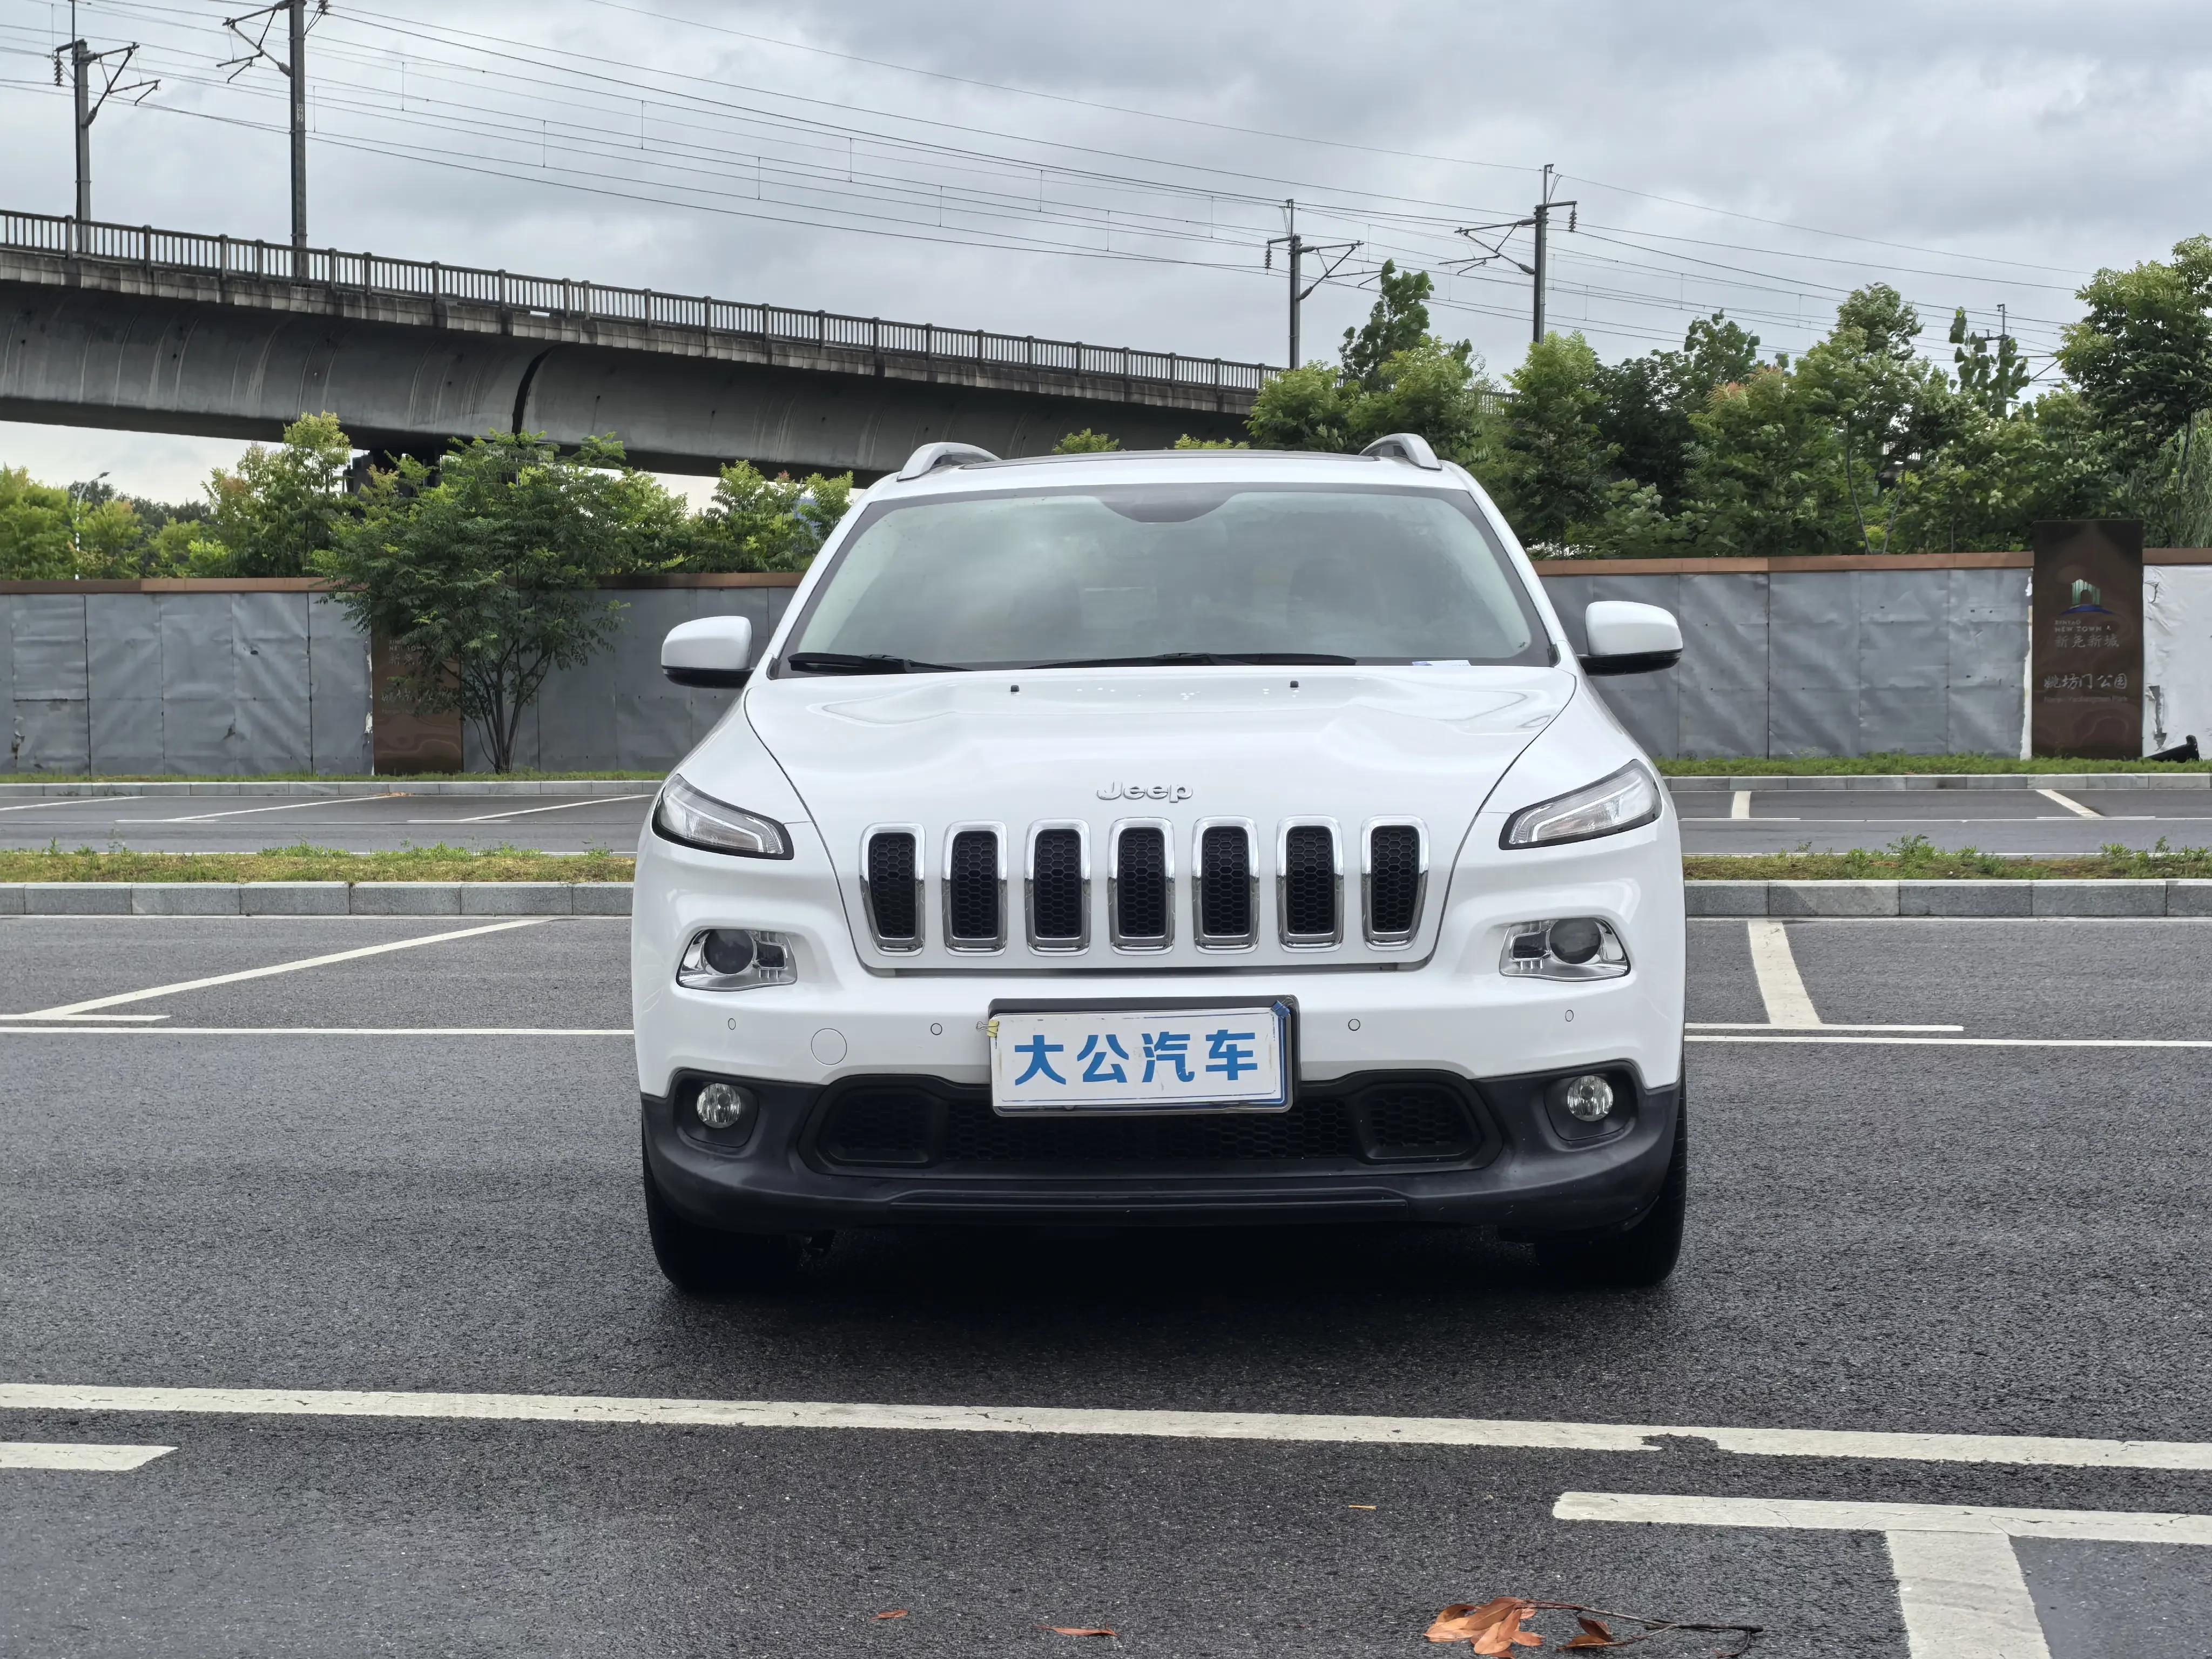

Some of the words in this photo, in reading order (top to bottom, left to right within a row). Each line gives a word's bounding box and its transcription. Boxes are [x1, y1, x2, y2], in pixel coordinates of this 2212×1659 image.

[1097, 780, 1193, 803] Jeep
[1014, 1029, 1258, 1086] 大公汽车
